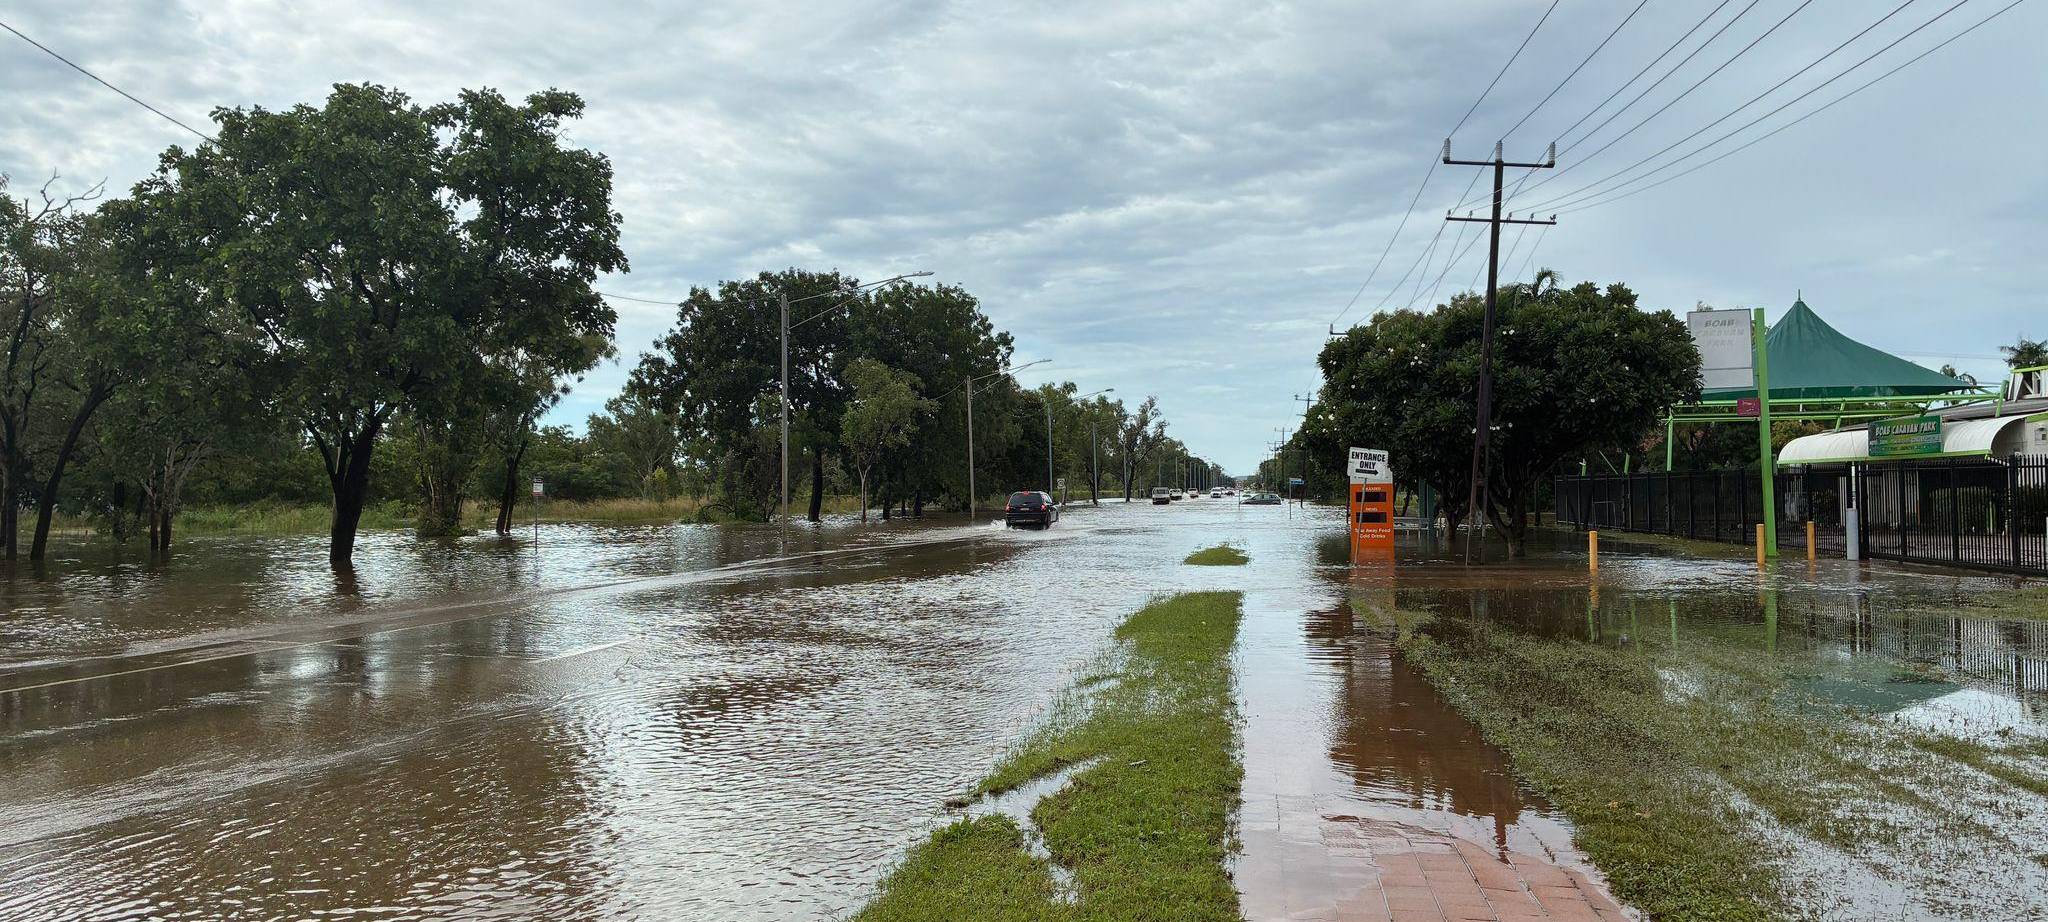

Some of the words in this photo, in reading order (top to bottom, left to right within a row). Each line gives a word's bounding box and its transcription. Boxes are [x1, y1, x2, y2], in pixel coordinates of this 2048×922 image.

[1704, 319, 1735, 327] BOAB
[1875, 426, 1891, 436] BOAB
[1892, 424, 1919, 435] CARAVAN
[1920, 422, 1936, 432] PARK
[1351, 451, 1386, 462] ENTRANCE
[1360, 461, 1376, 469] ONLY
